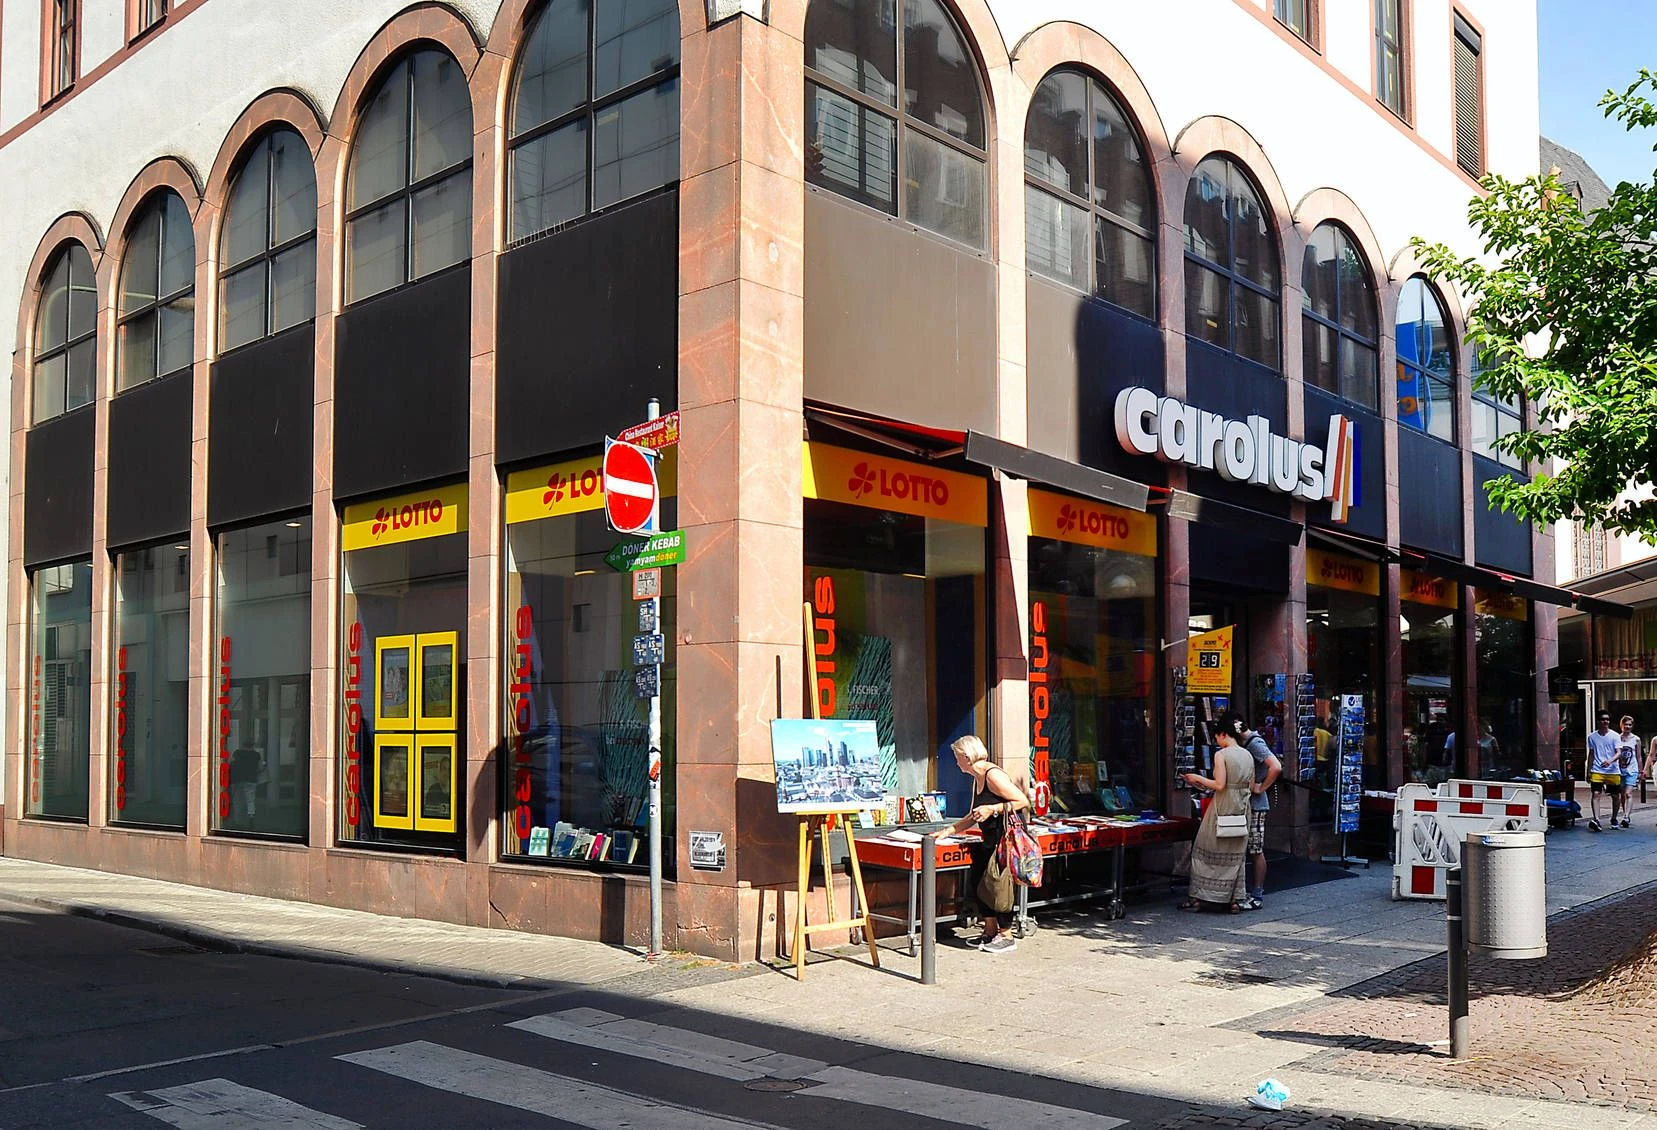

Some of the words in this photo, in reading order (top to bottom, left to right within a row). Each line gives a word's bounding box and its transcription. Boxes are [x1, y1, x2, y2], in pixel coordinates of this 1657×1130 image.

[880, 469, 949, 507] LOTTO
[1114, 386, 1324, 500] carolus
[392, 498, 443, 531] LOTTO
[651, 536, 681, 551] KEBAB
[1079, 510, 1129, 540] LOTTO
[1334, 562, 1364, 584] LOTTO
[32, 655, 41, 803] carolus
[115, 646, 127, 810] carolus
[217, 635, 231, 818] carolus
[344, 621, 362, 826] carolus
[511, 604, 532, 839] carolus
[1029, 600, 1050, 817] carolus
[1049, 835, 1098, 852] carolus
